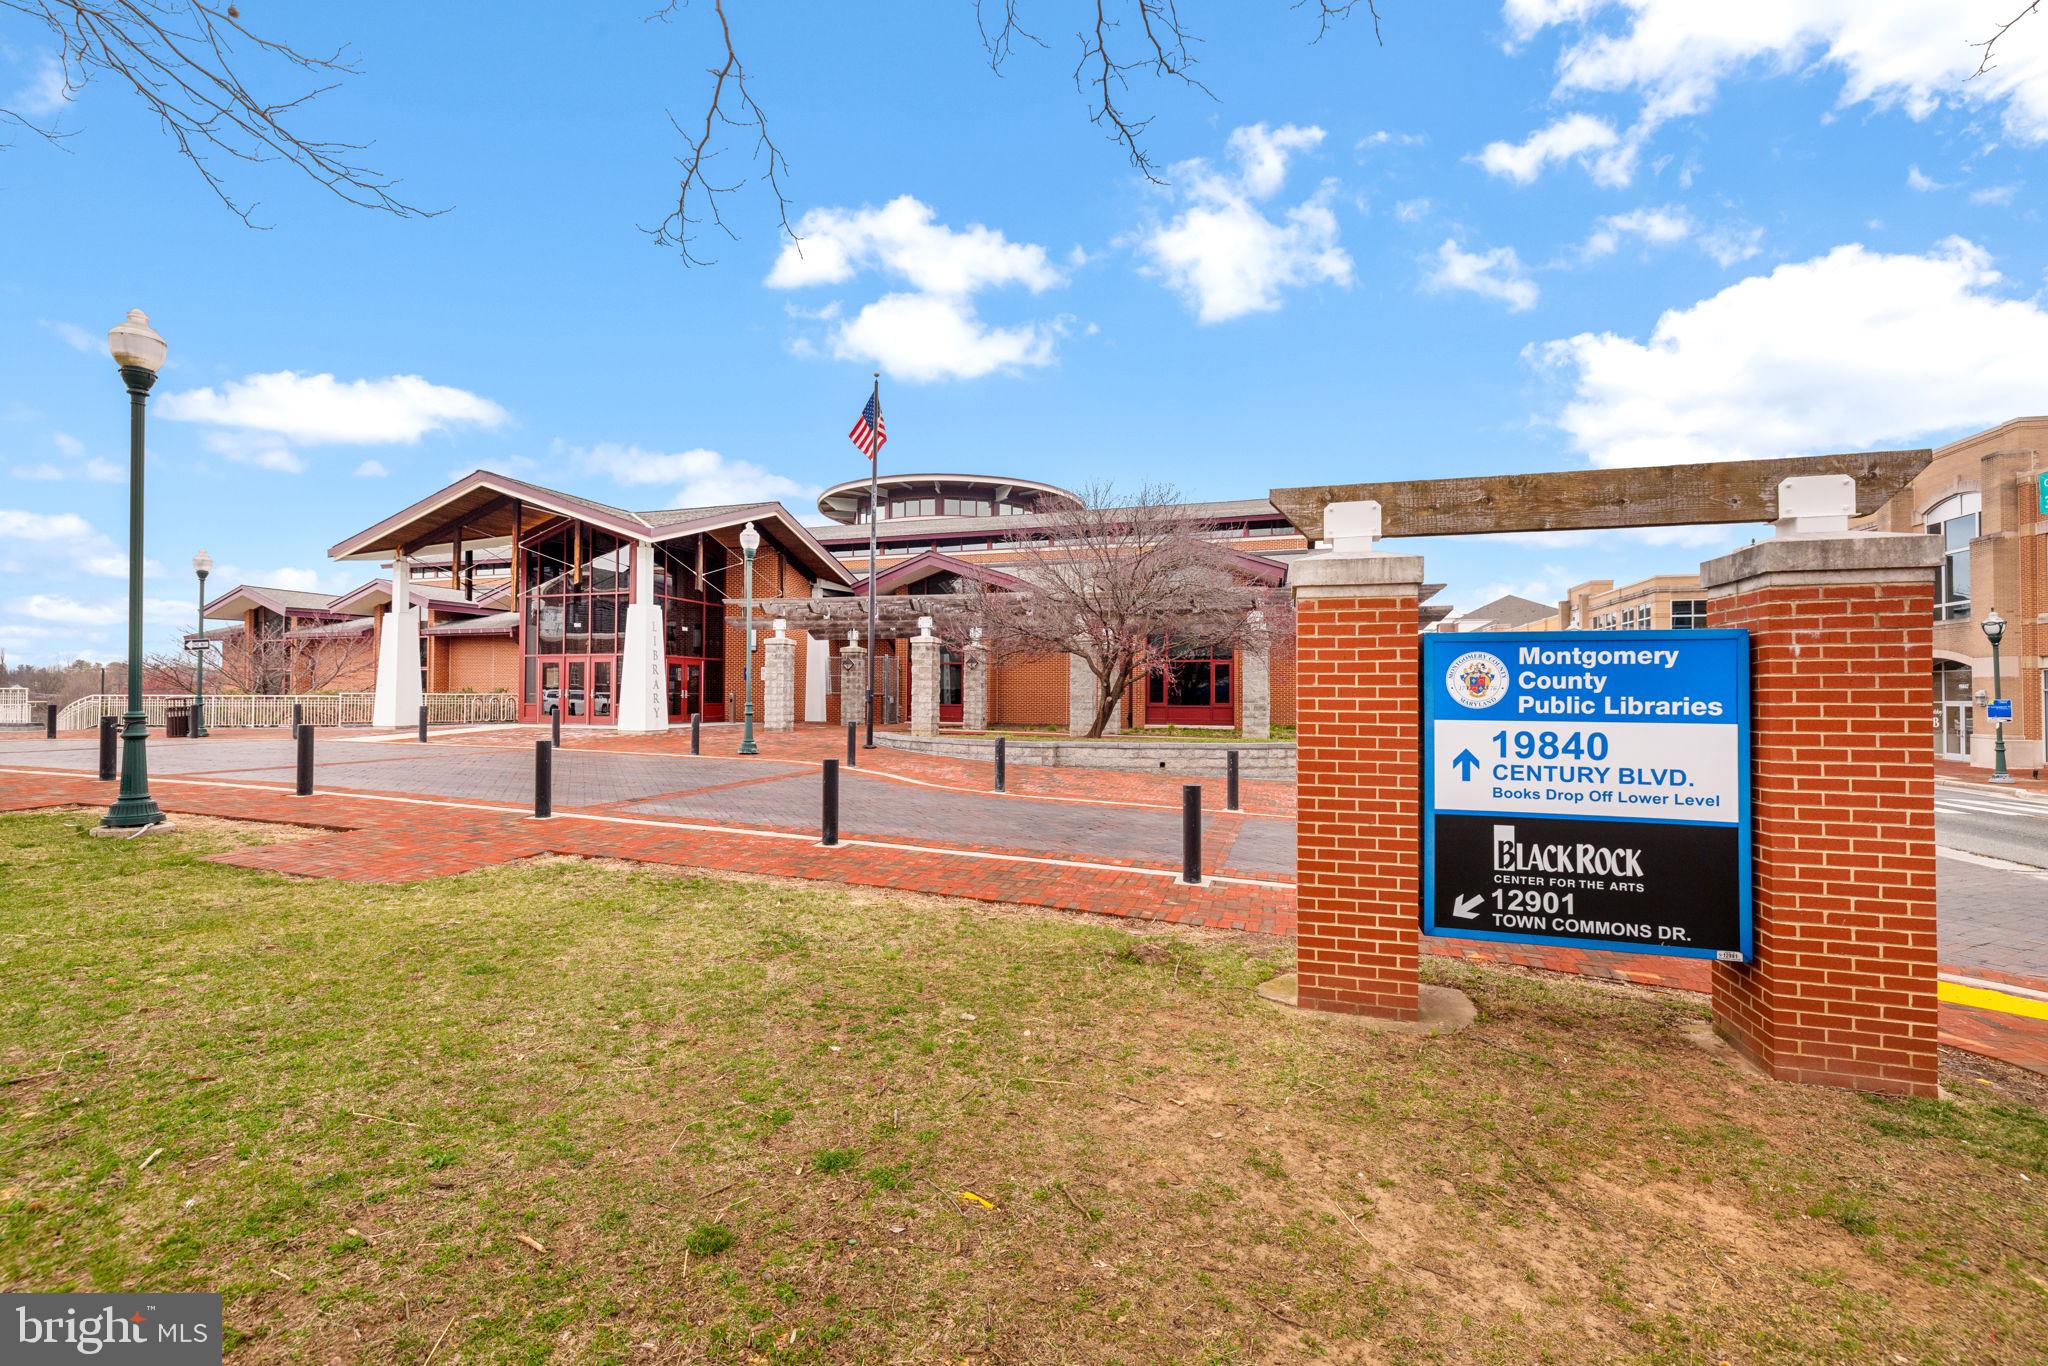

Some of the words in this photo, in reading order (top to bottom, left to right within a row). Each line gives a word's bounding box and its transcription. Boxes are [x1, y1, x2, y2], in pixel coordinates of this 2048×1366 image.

[1448, 653, 1487, 679] MONTGOMERY
[1488, 656, 1507, 679] COUNTY
[1518, 646, 1680, 669] Montgomery
[652, 621, 660, 718] LIBRARY
[1518, 671, 1608, 694] County
[1460, 697, 1497, 708] MARYLAND
[1518, 695, 1596, 715] Public
[1604, 696, 1724, 716] Libraries
[1492, 730, 1609, 761] 19840
[1492, 763, 1611, 784] CENTURY
[1618, 767, 1694, 787] BLVD.
[1492, 786, 1541, 800] Books
[1546, 788, 1584, 804] Drop
[1588, 790, 1614, 803] Off
[1618, 792, 1669, 805] Lower
[1674, 793, 1721, 807] Level
[1493, 874, 1545, 886] CENTER
[1549, 878, 1576, 888] FOR
[1578, 879, 1605, 890] THE
[1609, 881, 1645, 893] ARTS
[1491, 888, 1574, 915] 12901
[1492, 913, 1546, 930] TOWN
[1551, 918, 1652, 938] COMMONS
[1658, 925, 1692, 942] DR.
